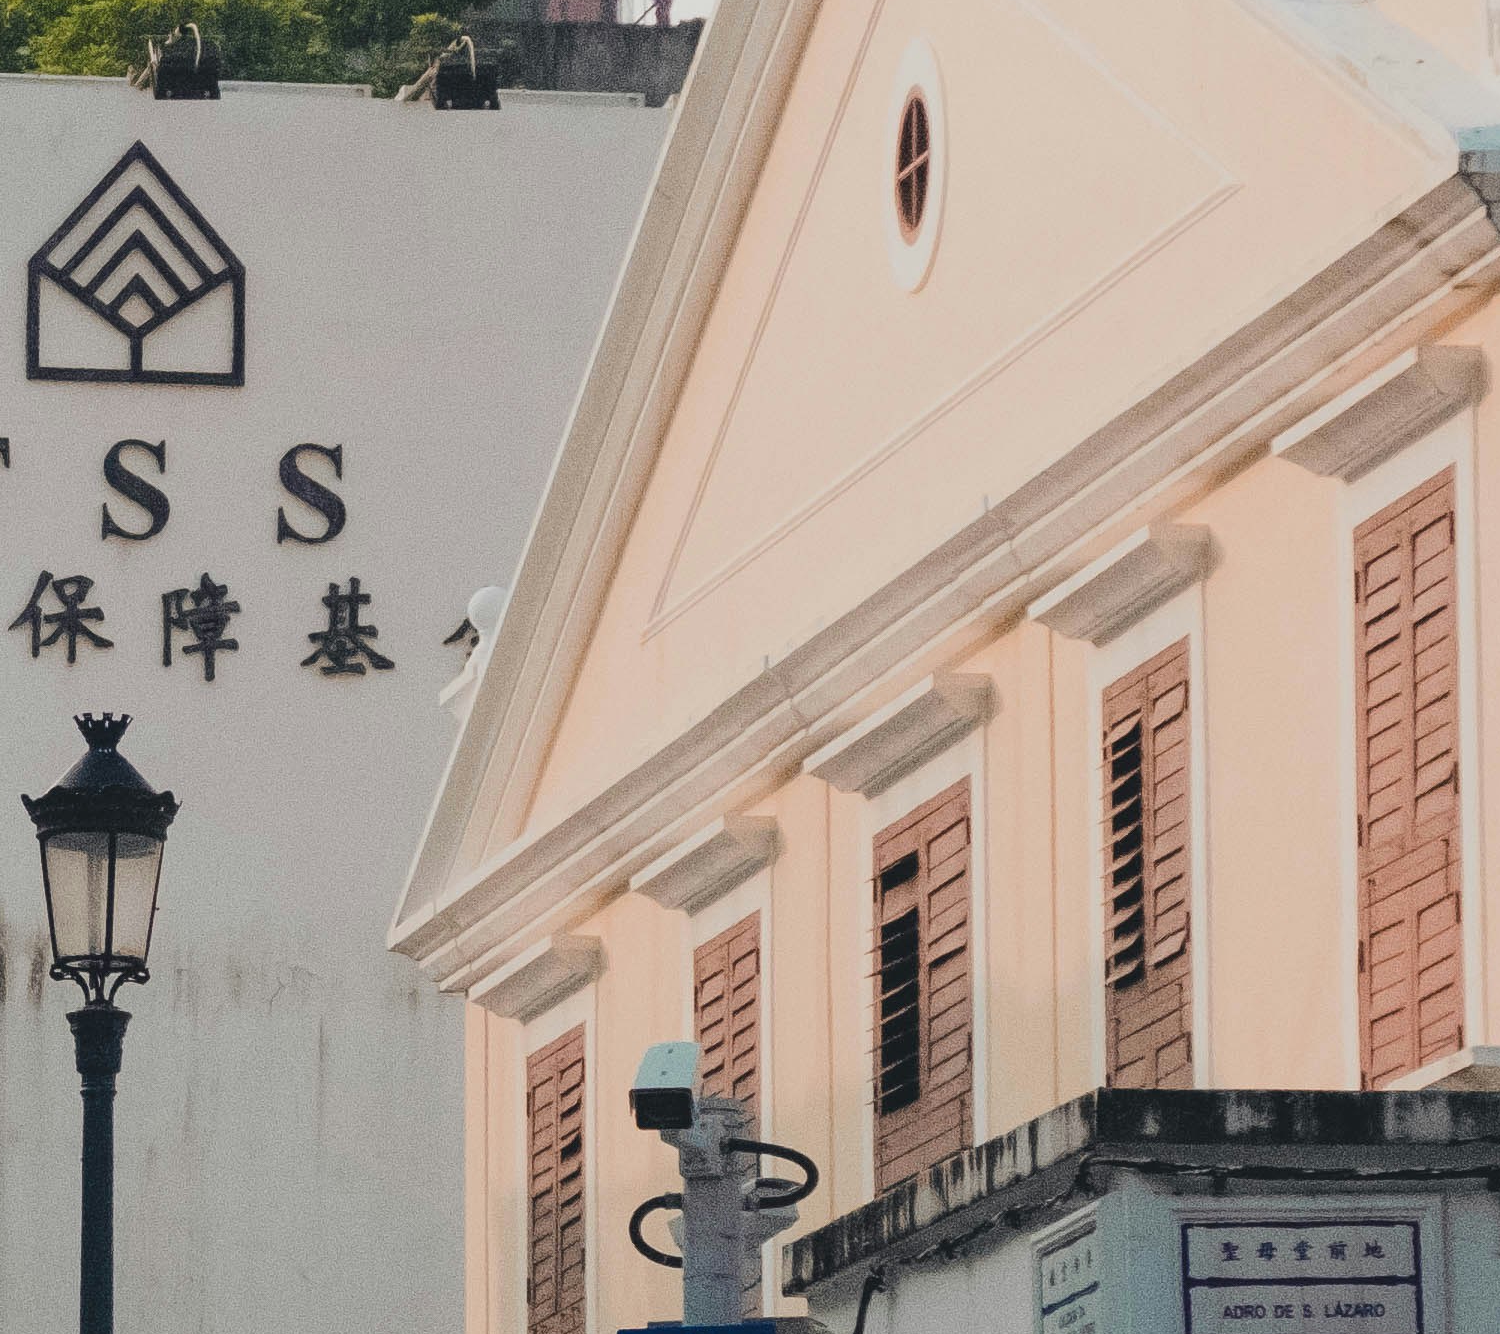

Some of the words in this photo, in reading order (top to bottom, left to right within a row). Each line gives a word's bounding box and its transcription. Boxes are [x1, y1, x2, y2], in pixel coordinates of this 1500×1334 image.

[1222, 1304, 1266, 1320] ADRO
[1274, 1304, 1294, 1319] DE
[1323, 1300, 1386, 1319] LÁZARO
